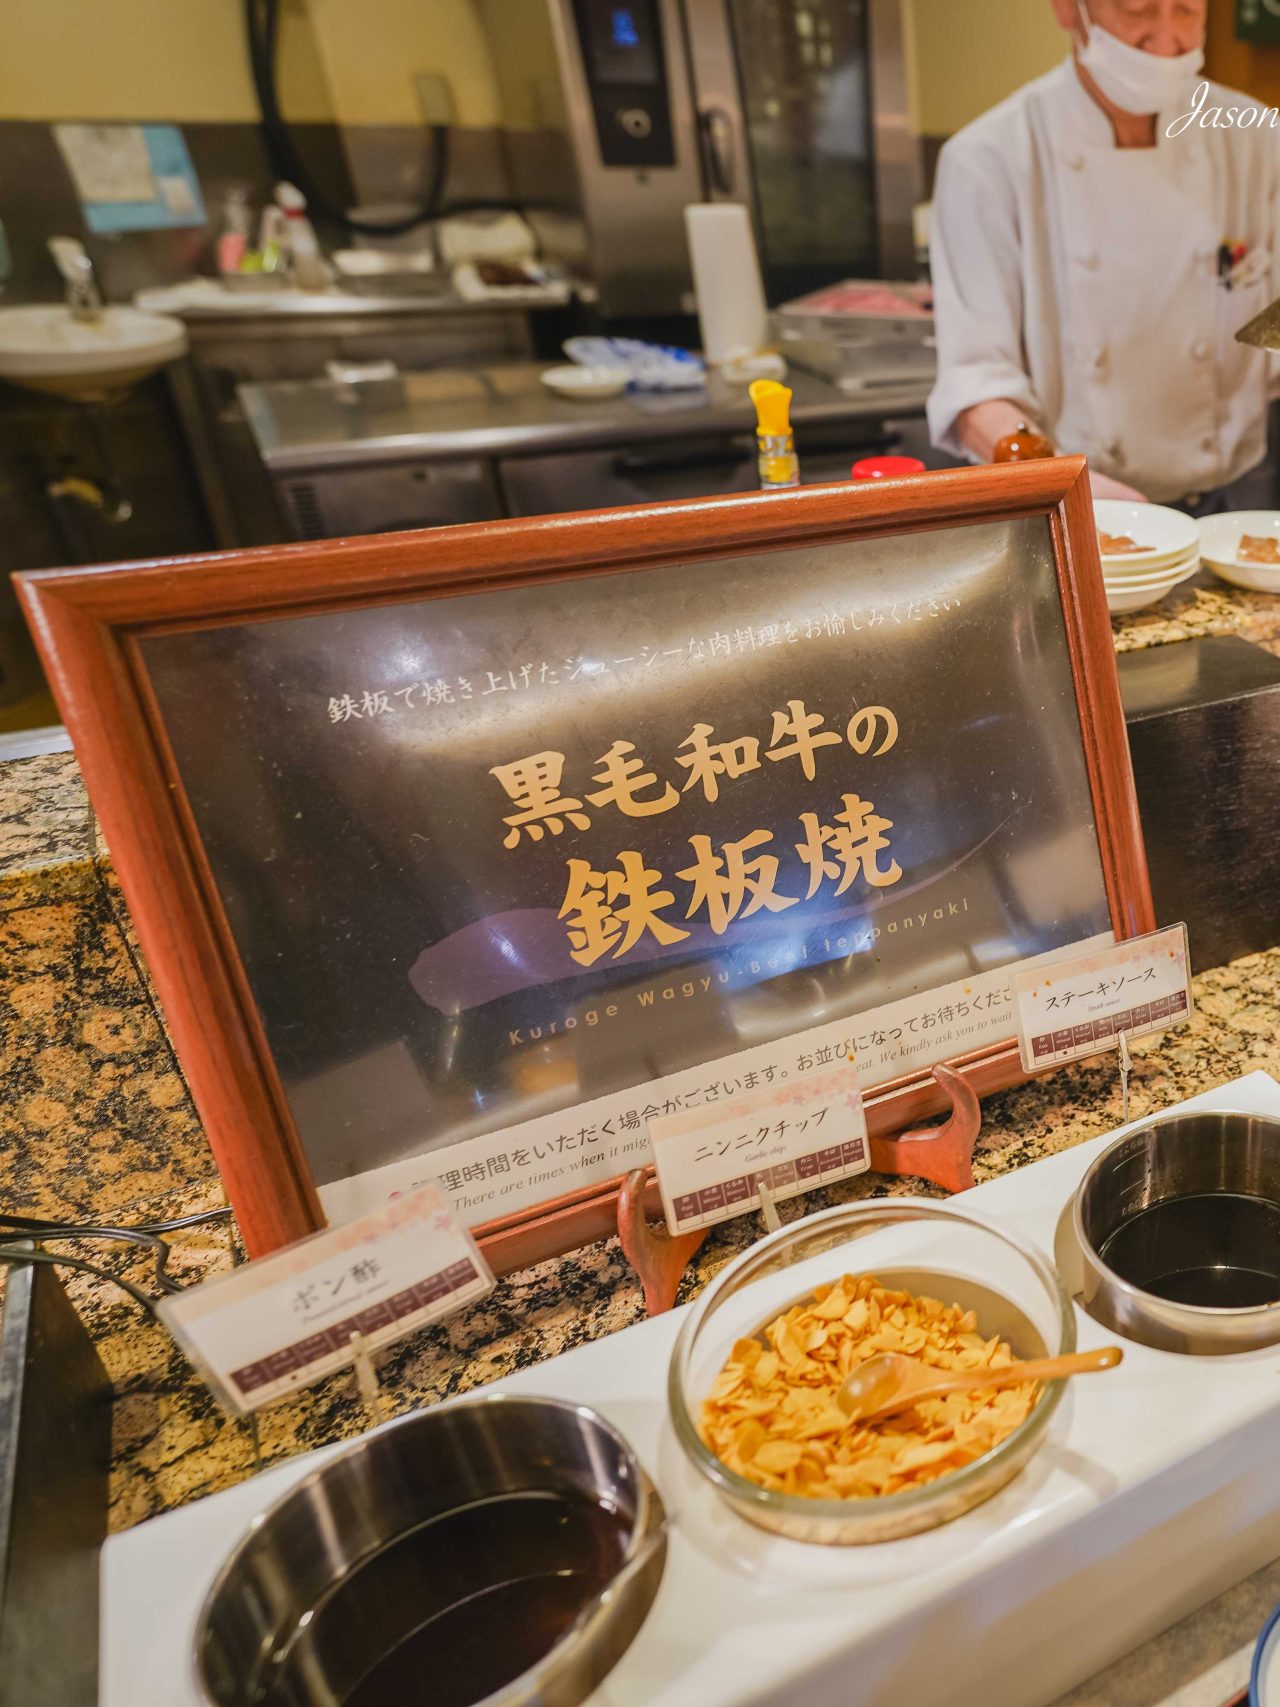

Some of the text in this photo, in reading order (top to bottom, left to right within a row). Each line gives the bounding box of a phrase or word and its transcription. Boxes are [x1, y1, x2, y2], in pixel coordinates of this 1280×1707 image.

[327, 597, 961, 724] 鉄板で焼き上げたジューシーな肉料理をお愉しみください
[489, 700, 900, 850] 黒毛和牛の
[557, 792, 903, 967] 鉄板焼
[509, 1001, 619, 1047] Kuroge
[824, 898, 969, 952] teppanyaki
[1045, 967, 1157, 1012] ステーキソース
[452, 1190, 496, 1211] There
[500, 1181, 524, 1195] are
[528, 1166, 566, 1187] times
[569, 1151, 606, 1172] when
[610, 1146, 618, 1158] it
[880, 1050, 897, 1063] We
[900, 1037, 933, 1056] kindly
[935, 1030, 954, 1045] ask
[955, 1026, 975, 1041] you
[977, 1019, 988, 1031] to
[991, 1010, 1012, 1025] wait
[693, 1106, 829, 1162] ニンニクチップ
